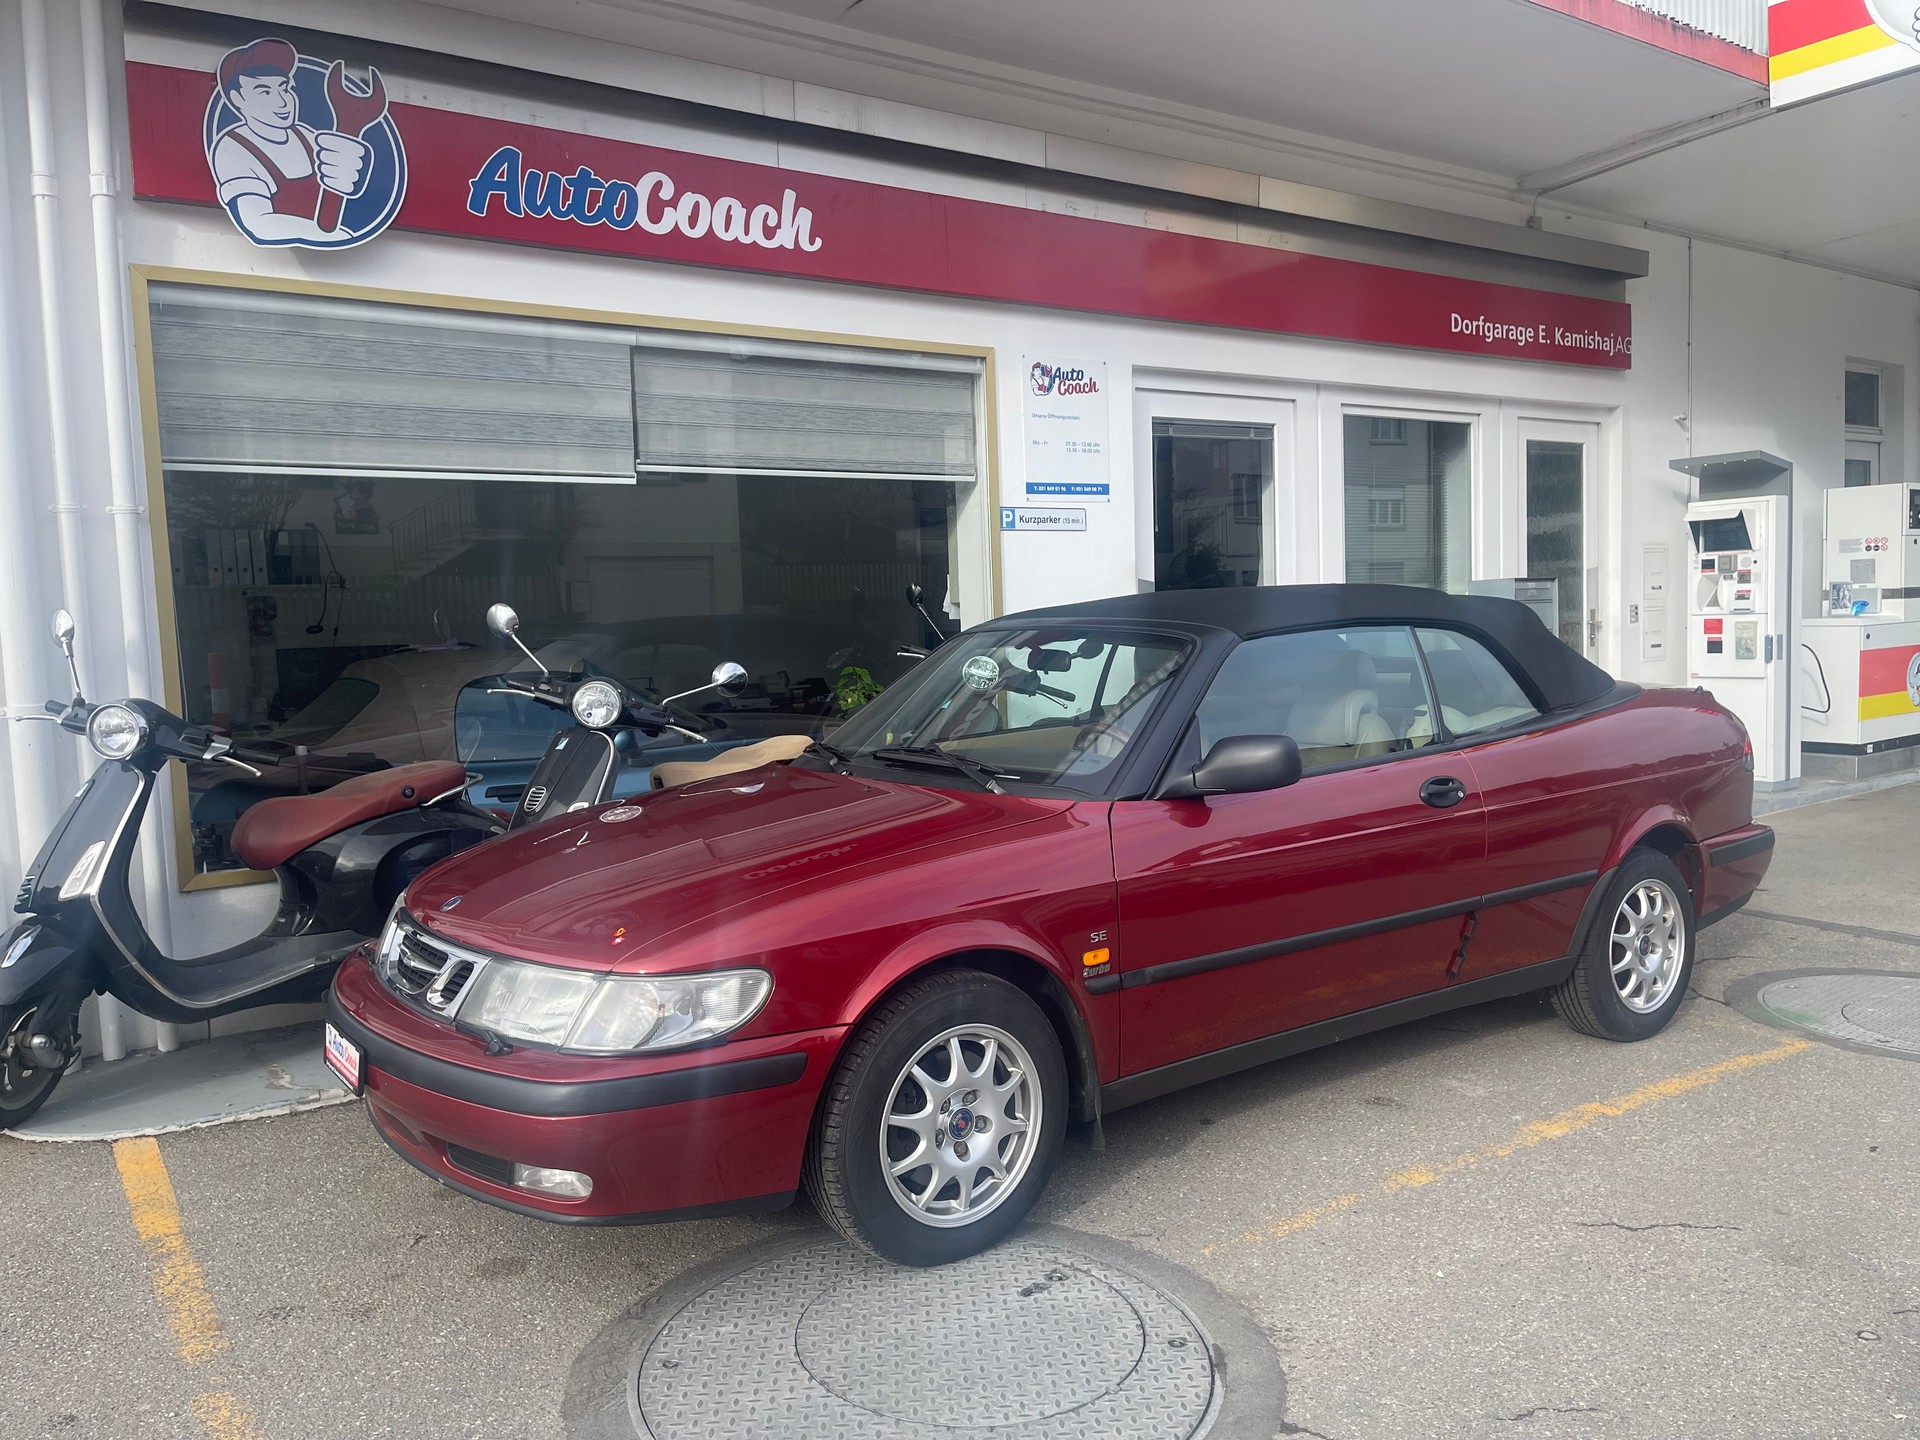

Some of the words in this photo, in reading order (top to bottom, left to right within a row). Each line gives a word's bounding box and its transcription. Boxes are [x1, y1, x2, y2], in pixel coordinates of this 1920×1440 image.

[1451, 313, 1534, 346] Dorfgarage
[1538, 325, 1550, 344] E.
[1554, 327, 1614, 356] Kamishaj
[1052, 367, 1084, 384] Auto
[1057, 377, 1099, 396] Coach
[1019, 515, 1061, 525] Kurzparker
[1090, 930, 1108, 943] SE
